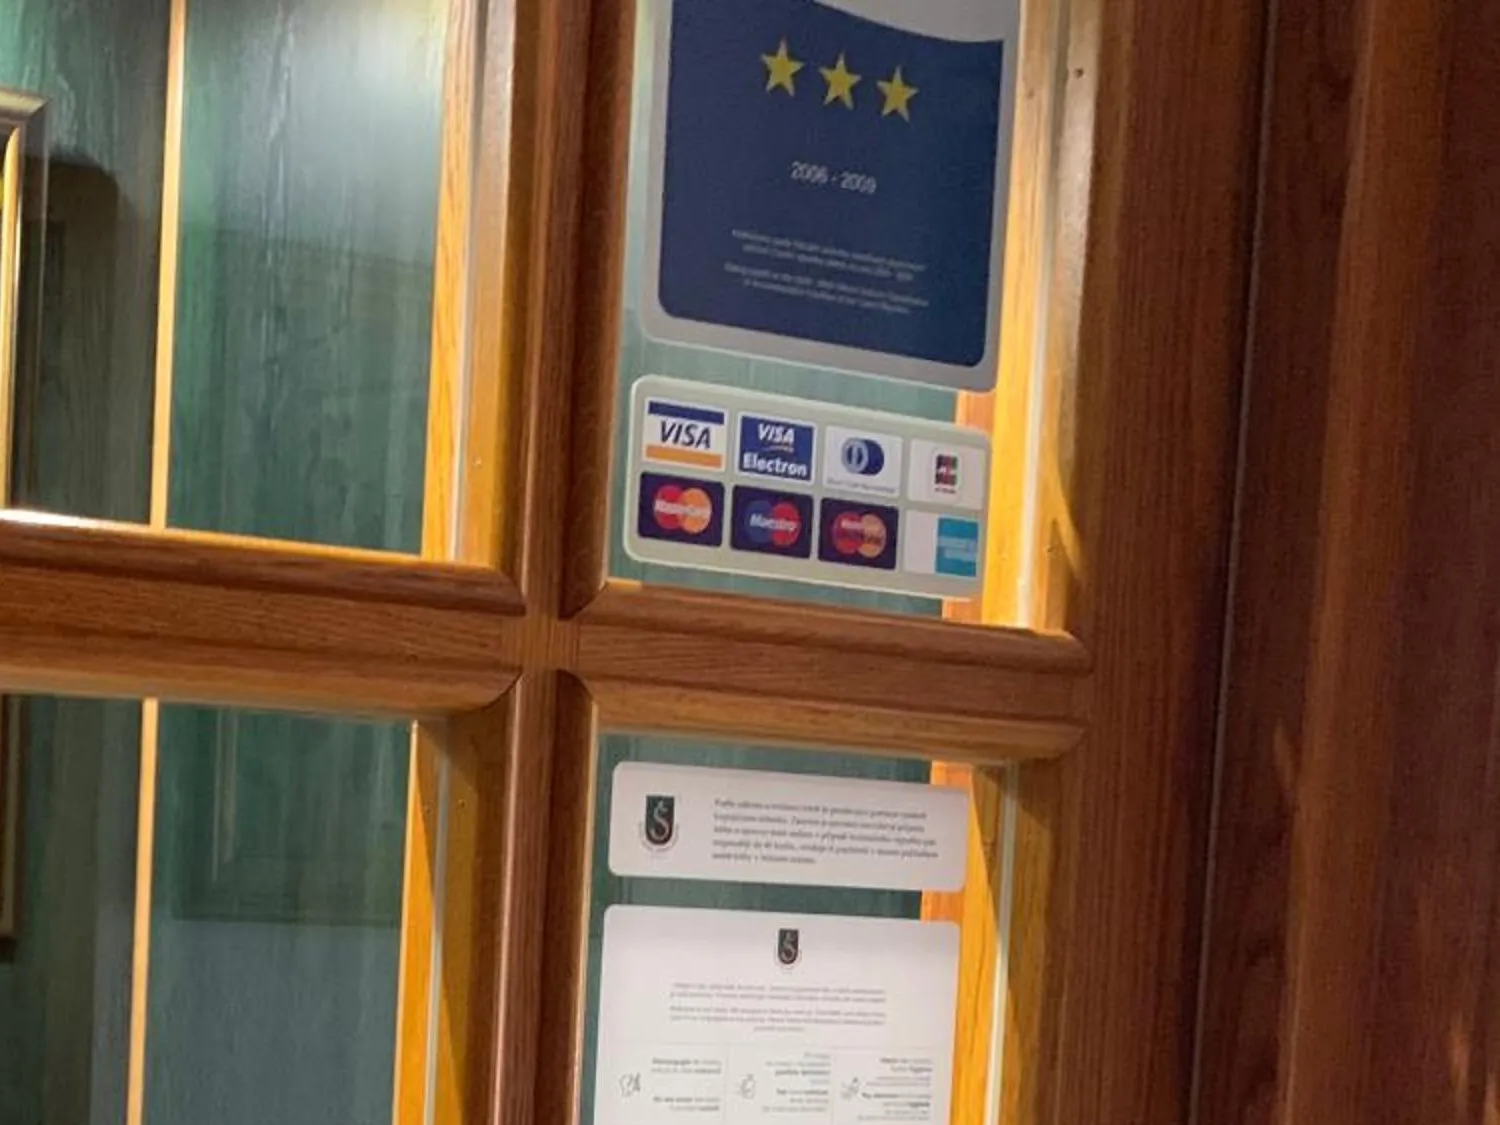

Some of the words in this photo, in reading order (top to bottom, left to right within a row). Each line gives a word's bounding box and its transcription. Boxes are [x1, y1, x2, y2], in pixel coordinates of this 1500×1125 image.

[660, 421, 711, 449] VISA
[758, 423, 795, 443] VISA
[743, 452, 807, 477] Electron
